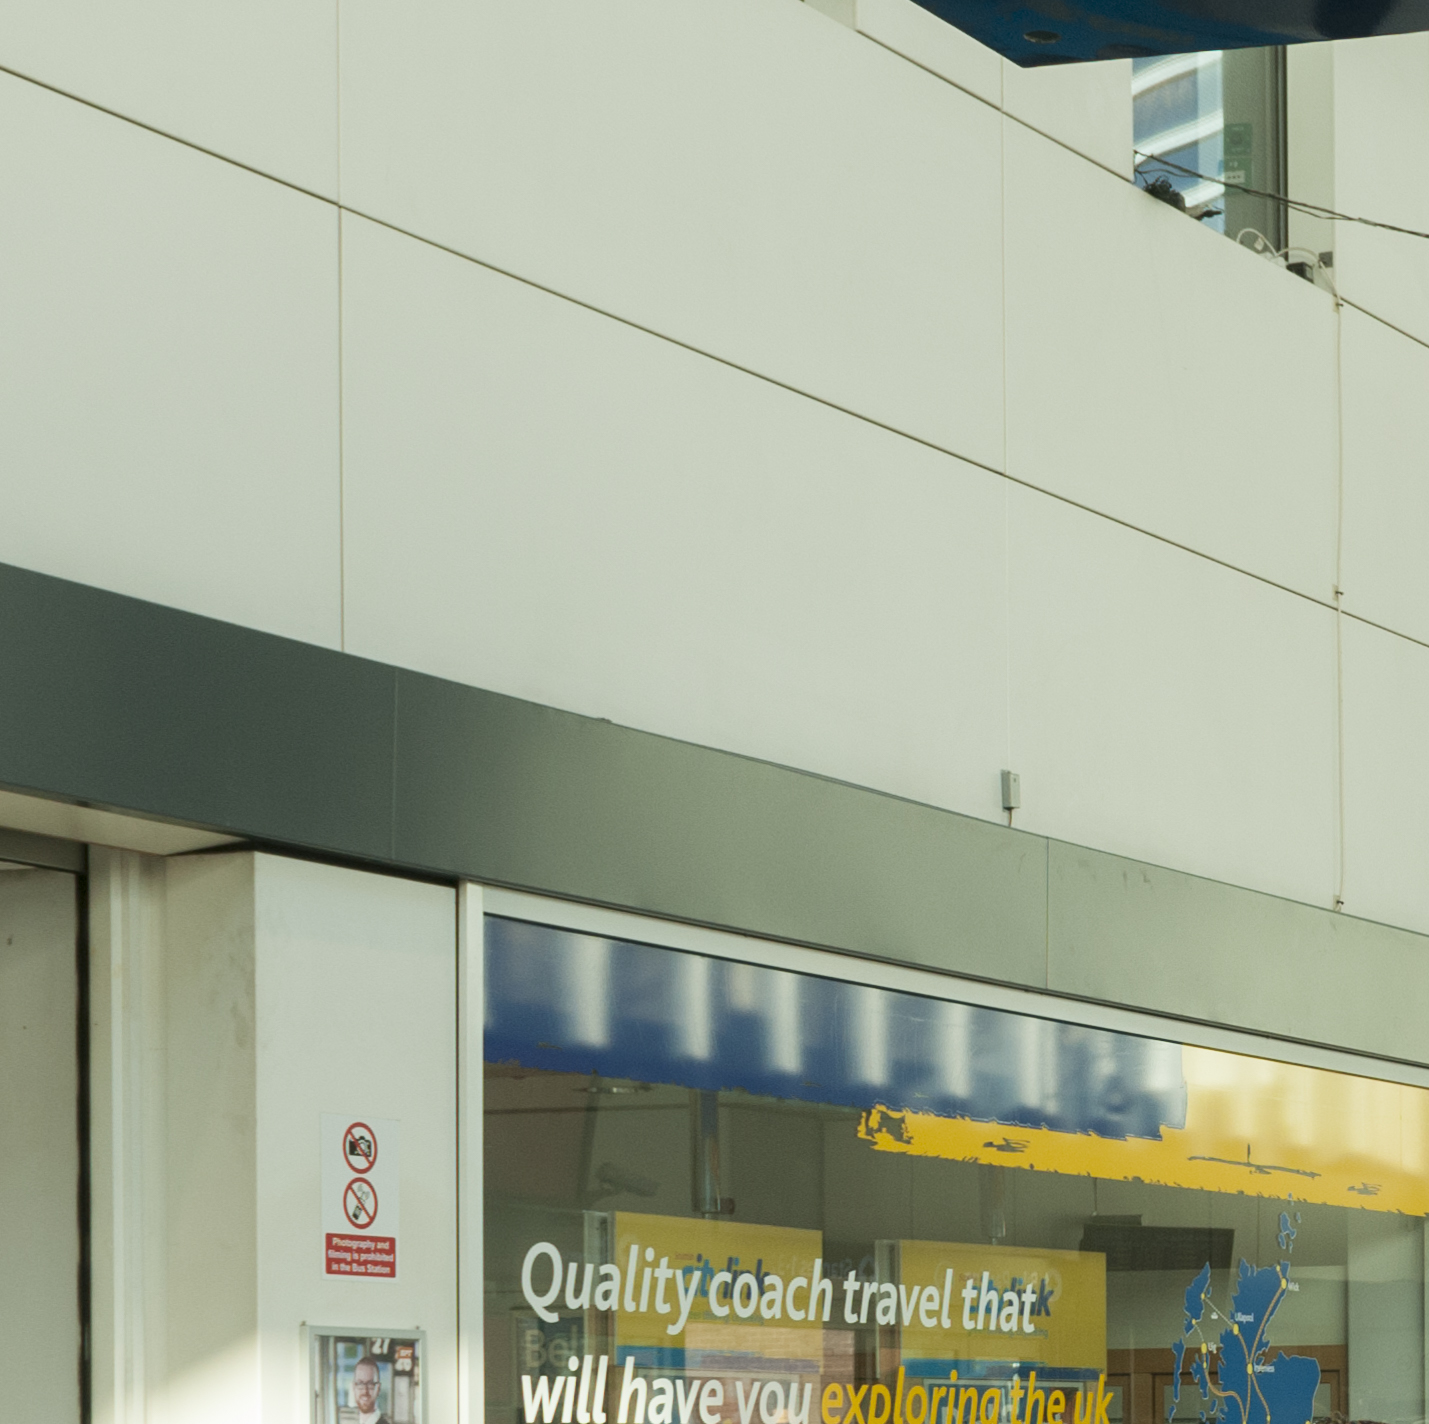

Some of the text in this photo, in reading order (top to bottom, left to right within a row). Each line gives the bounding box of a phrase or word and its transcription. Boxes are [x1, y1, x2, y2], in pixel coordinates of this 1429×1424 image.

[332, 1238, 389, 1250] Photography and
[328, 1249, 394, 1263] filming is prohibited
[332, 1262, 390, 1274] in the Bus Station
[521, 1241, 1038, 1336] Quality coach travel that
[521, 1354, 609, 1424] will
